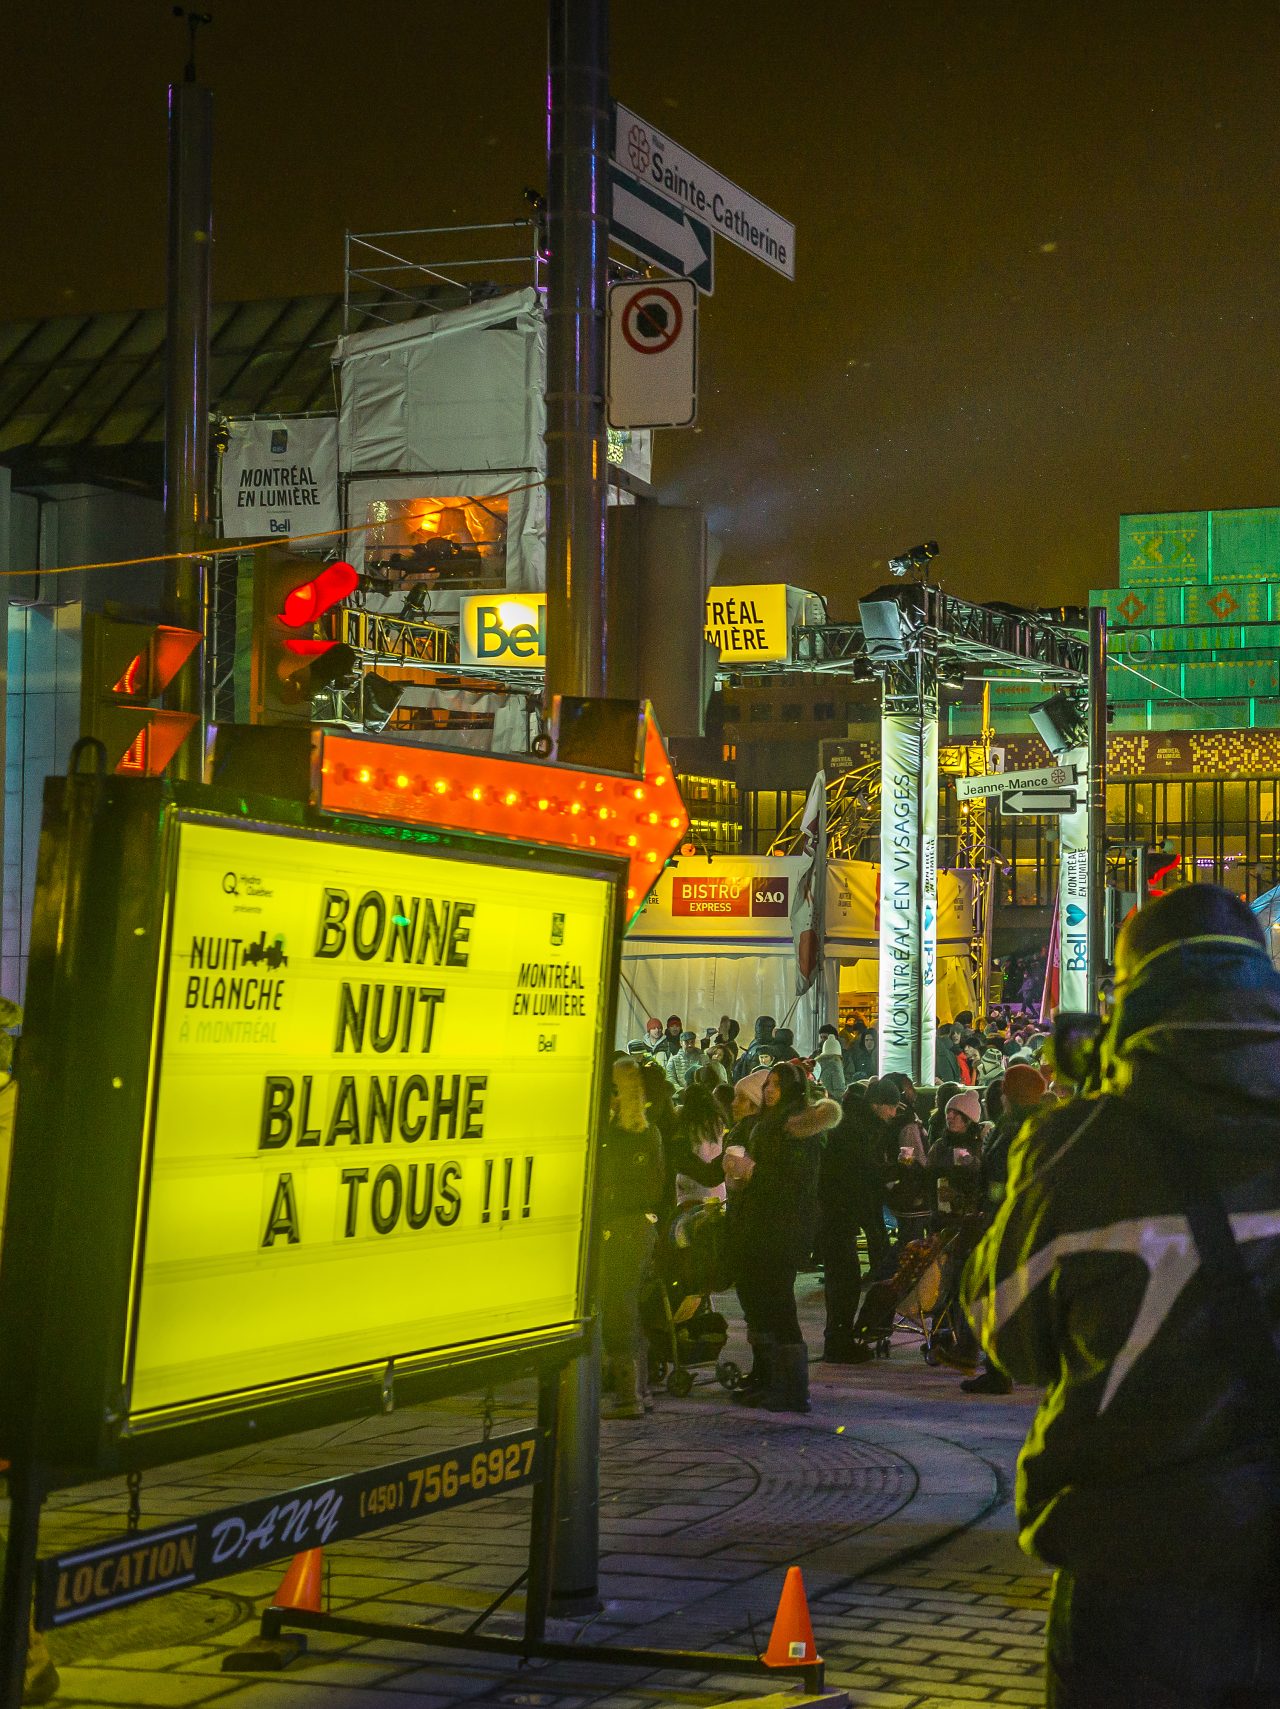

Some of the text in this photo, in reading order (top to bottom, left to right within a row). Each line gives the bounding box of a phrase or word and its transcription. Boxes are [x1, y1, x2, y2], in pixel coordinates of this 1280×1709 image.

[652, 153, 787, 264] Sainte-Catherine
[240, 465, 317, 487] MONTRÉAL
[237, 487, 320, 508] EN LUMIÈRE
[270, 519, 290, 533] Bell
[963, 777, 1048, 796] Jeanne-Mance
[1068, 848, 1077, 896] MONTRÉAL
[1078, 846, 1087, 897] EN LUMIÈRE
[682, 884, 740, 899] BISTRO
[689, 902, 732, 912] EXPRESS
[755, 891, 785, 904] SAQ
[314, 887, 476, 967] BONNE
[893, 774, 910, 1047] MONTRÉAL EN VISAGES
[189, 936, 243, 970] NUIT
[1066, 933, 1087, 971] Bell
[517, 961, 585, 989] MONTRÉAL
[185, 976, 285, 1010] BLANCHE
[512, 991, 586, 1016] EN LUMIÈRE
[195, 1016, 277, 1044] MONTRÉAL
[333, 982, 445, 1053] NUIT
[537, 1034, 557, 1052] Bell
[258, 1074, 488, 1150] BLANCHE
[261, 1172, 300, 1248] A
[341, 1160, 462, 1238] TOUS
[55, 1439, 536, 1610] LOCATION DANY (450) 756-6927
